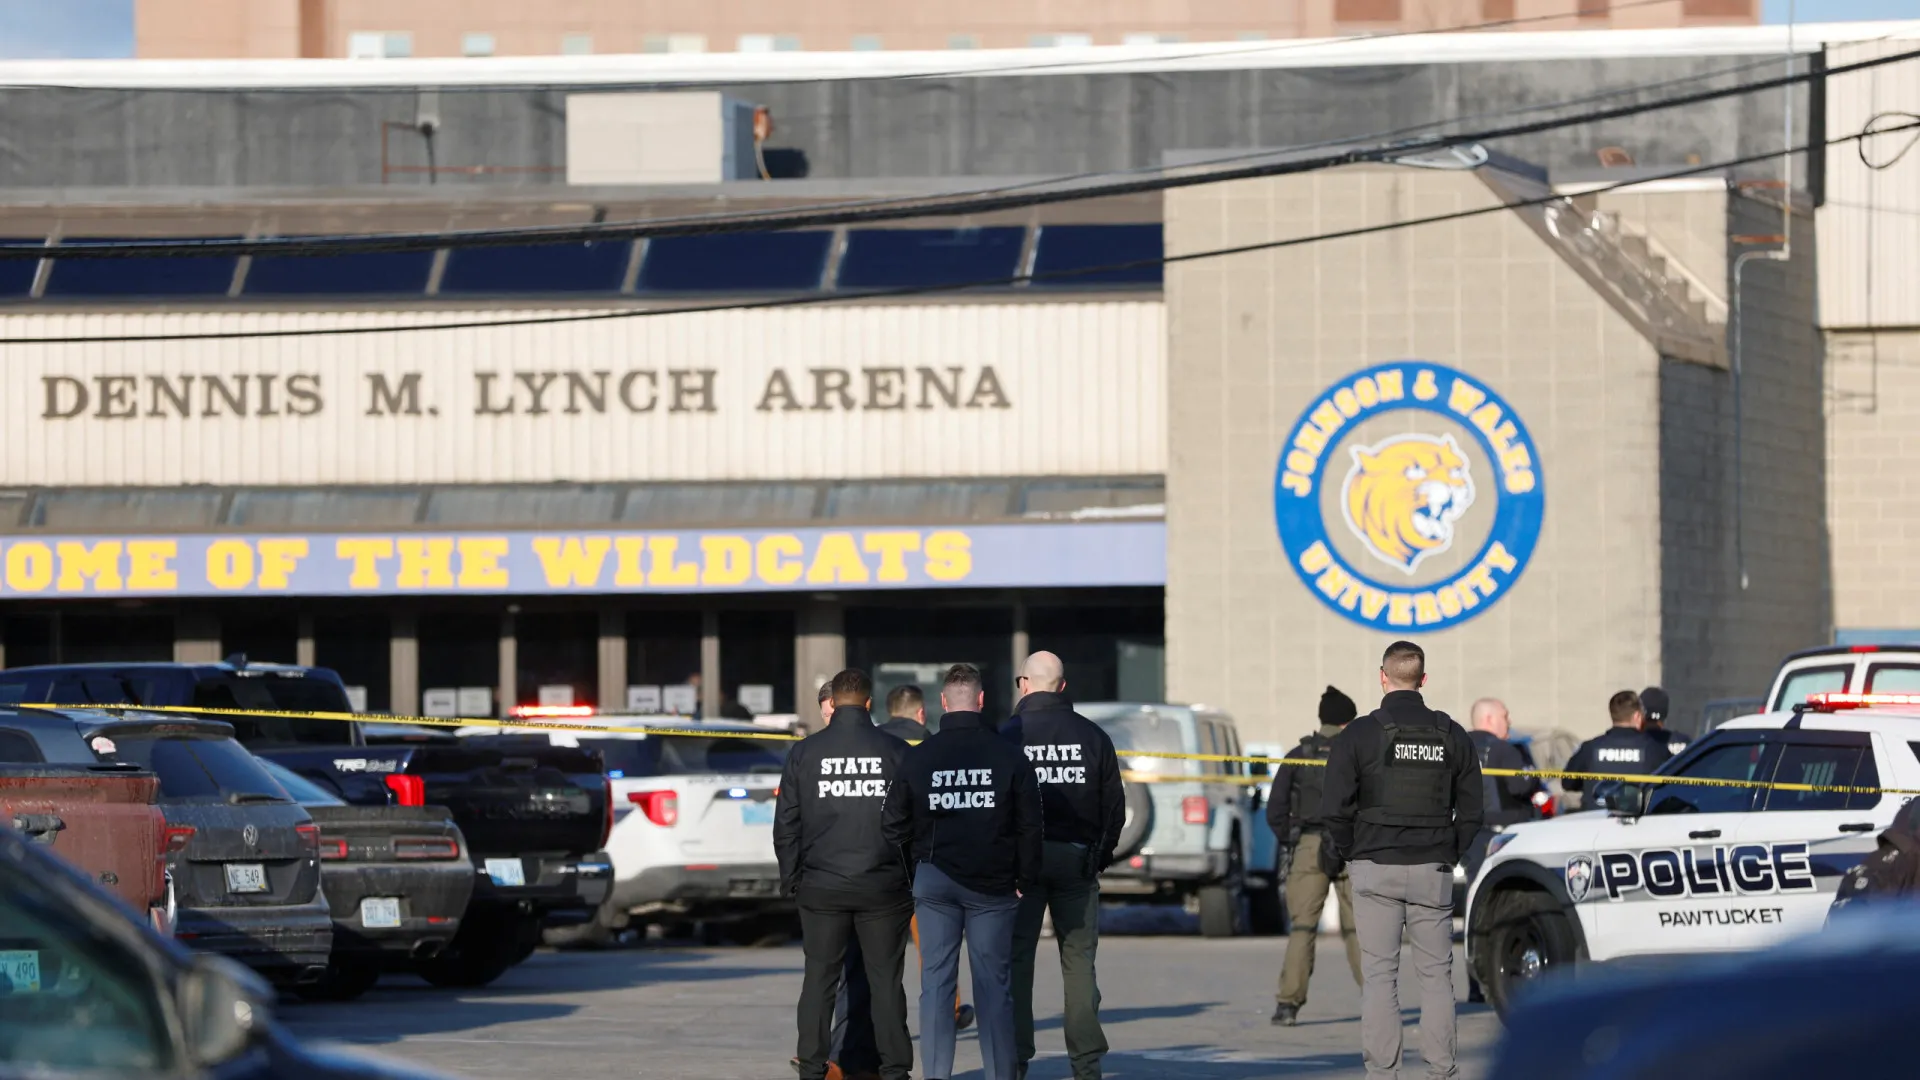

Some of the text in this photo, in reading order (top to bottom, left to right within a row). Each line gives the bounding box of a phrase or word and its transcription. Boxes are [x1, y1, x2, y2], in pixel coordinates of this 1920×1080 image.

[41, 365, 1012, 419] DENNIS M. LYNCH ARENA
[1282, 368, 1536, 497] JOHNSON & WALES
[0, 530, 972, 592] OME OF THE WILDCATS
[1299, 540, 1518, 625] UNIVERSITY
[1023, 744, 1082, 761] STATE
[1395, 744, 1444, 761] STATE POLICE
[1598, 748, 1640, 762] POLICE
[820, 757, 882, 775] STATE
[1036, 766, 1086, 784] OLICE
[931, 769, 992, 788] STATE
[818, 779, 886, 798] POLICE
[928, 791, 995, 811] POLICE
[1599, 840, 1816, 902] POLICE
[1659, 908, 1783, 927] PAWTUCKET
